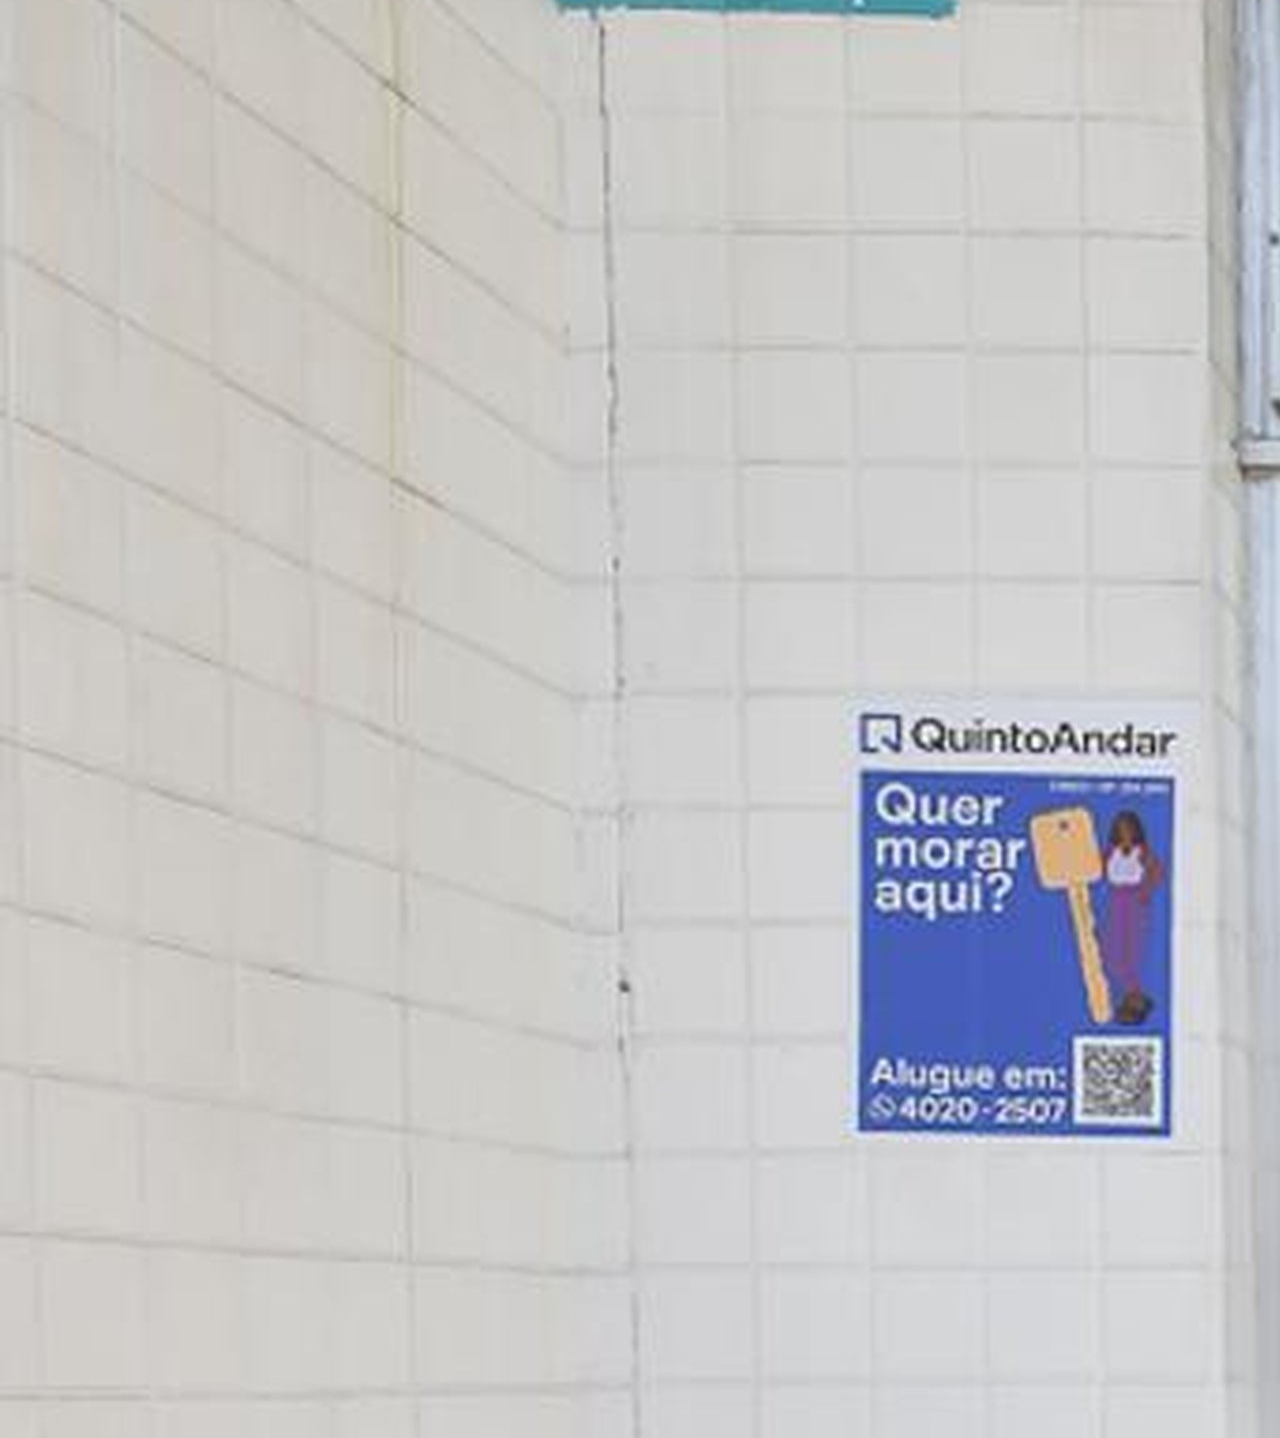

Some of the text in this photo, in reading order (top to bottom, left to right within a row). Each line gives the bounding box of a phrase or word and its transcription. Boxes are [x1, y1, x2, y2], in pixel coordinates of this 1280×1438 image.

[911, 717, 1177, 757] QuintoAndar
[875, 783, 1003, 825] Quer
[875, 836, 1026, 870] morar
[875, 872, 1014, 921] aqui?
[871, 1057, 1067, 1094] Alugue em:
